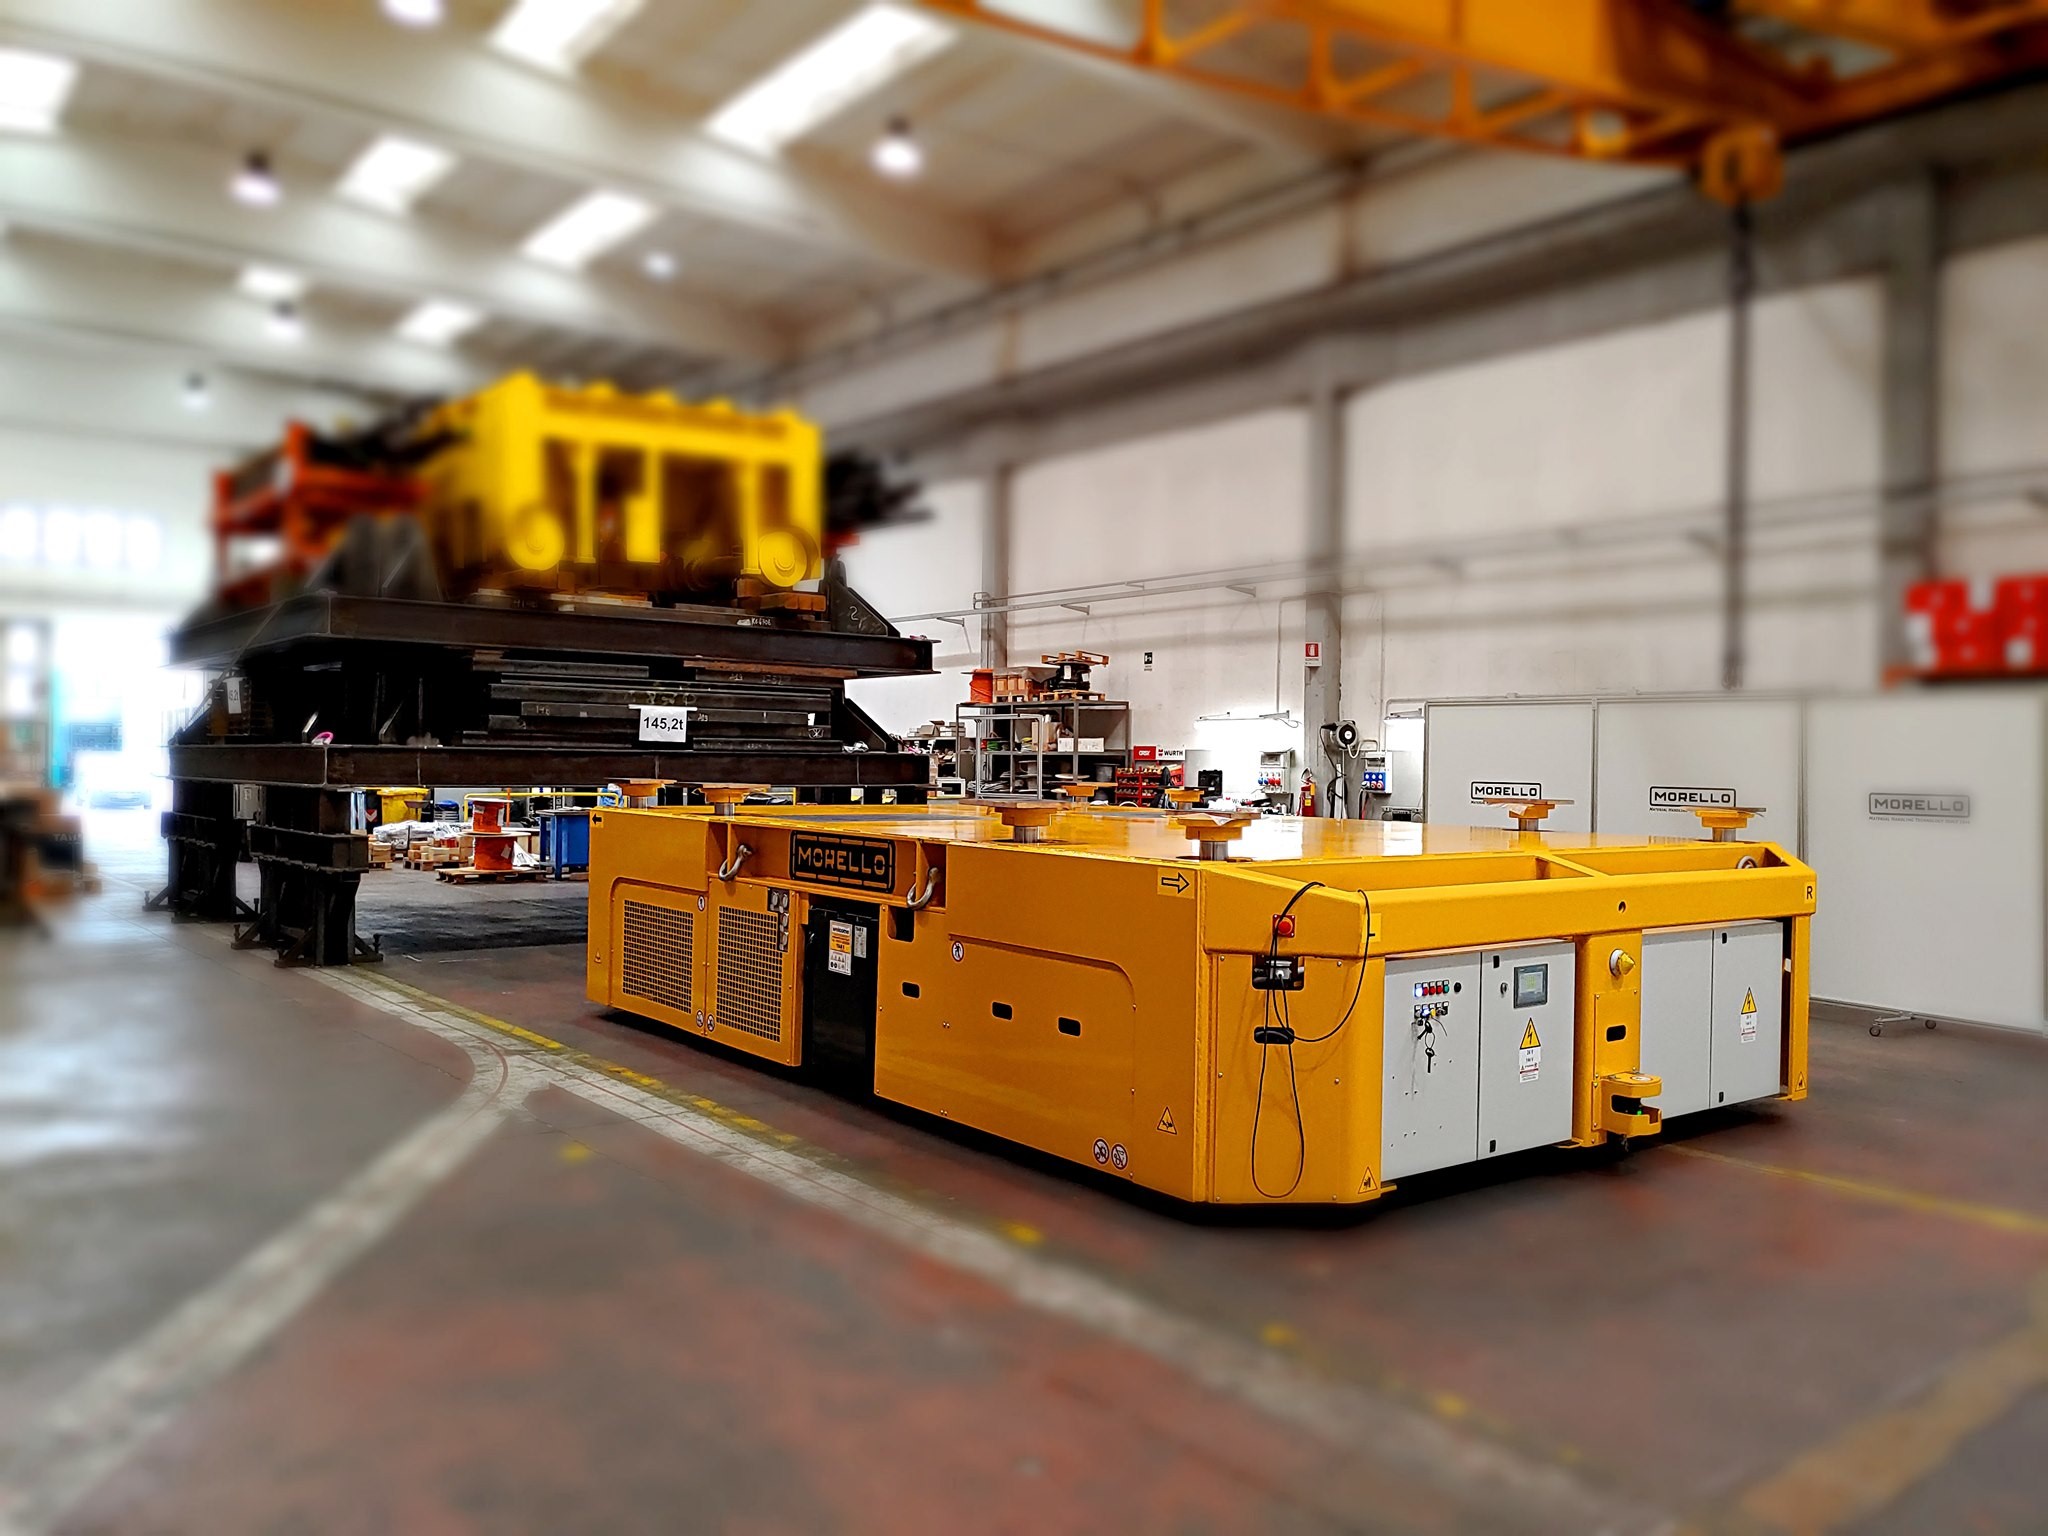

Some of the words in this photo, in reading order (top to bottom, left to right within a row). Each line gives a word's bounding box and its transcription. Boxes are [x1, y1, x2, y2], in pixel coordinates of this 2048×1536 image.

[643, 716, 684, 732] 145,2t
[1474, 786, 1538, 797] MORELLO
[1654, 791, 1731, 804] MORELLO
[1874, 798, 1964, 812] MORELLO
[798, 846, 886, 876] MORELLO
[1806, 885, 1813, 900] R
